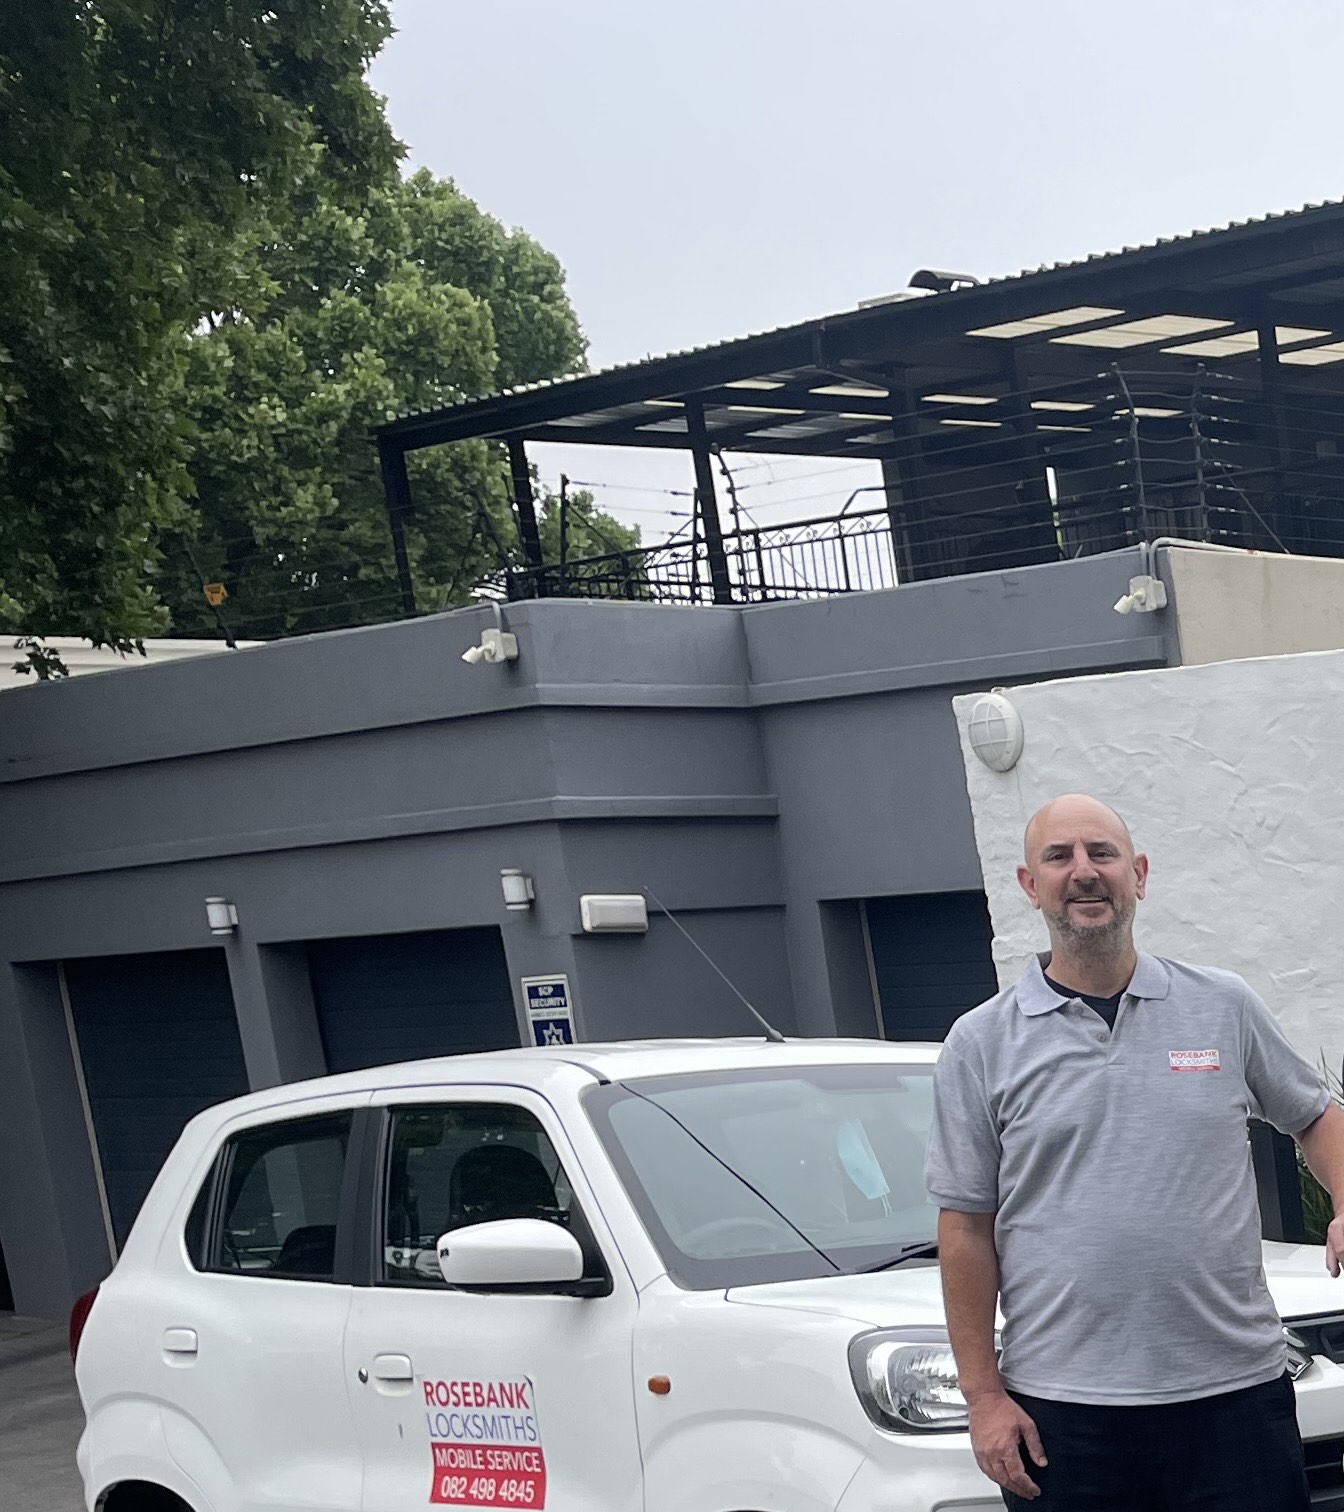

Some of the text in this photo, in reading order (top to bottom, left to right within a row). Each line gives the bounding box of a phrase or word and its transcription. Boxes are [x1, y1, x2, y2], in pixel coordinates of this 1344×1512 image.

[423, 1381, 530, 1409] ROSEBANK
[426, 1412, 537, 1442] LOCKSMITHS
[435, 1447, 541, 1472] MOBILE SERVICE
[441, 1476, 535, 1503] 082 498 4845
